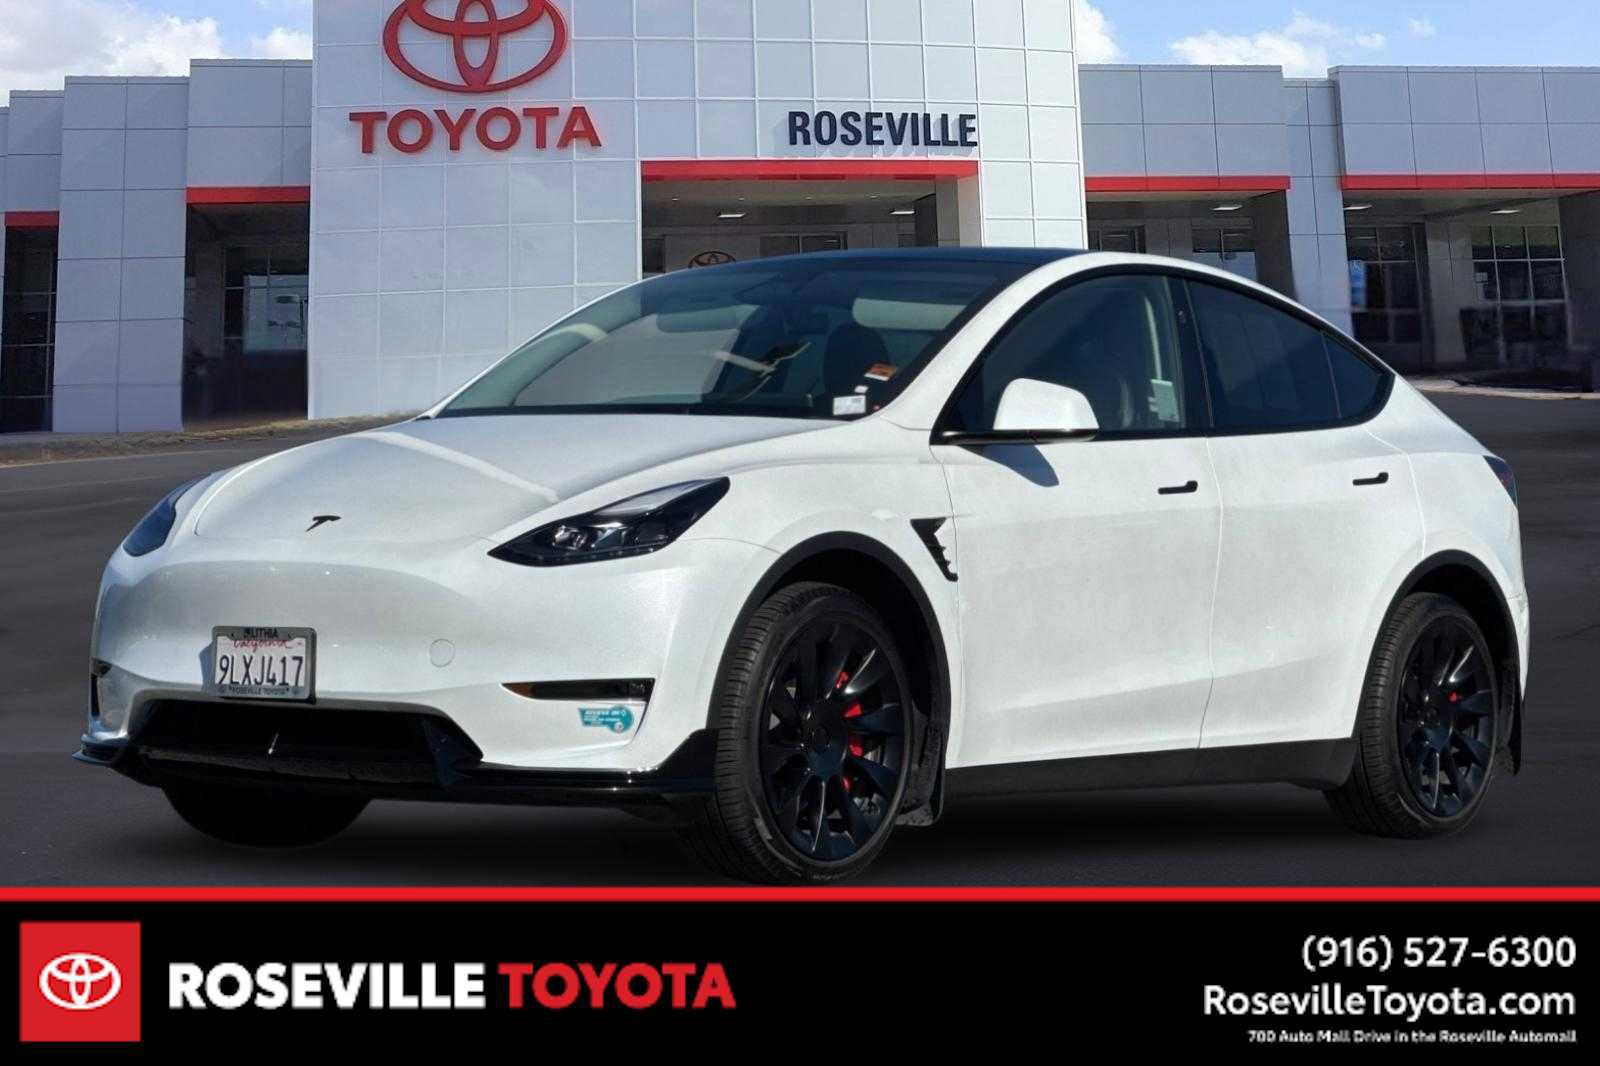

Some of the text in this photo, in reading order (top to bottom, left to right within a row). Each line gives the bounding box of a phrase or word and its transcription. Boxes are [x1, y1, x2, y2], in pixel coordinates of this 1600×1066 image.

[349, 106, 602, 154] TOYOTA
[788, 111, 979, 148] ROSEVILLE
[218, 656, 303, 687] 9LXJ417
